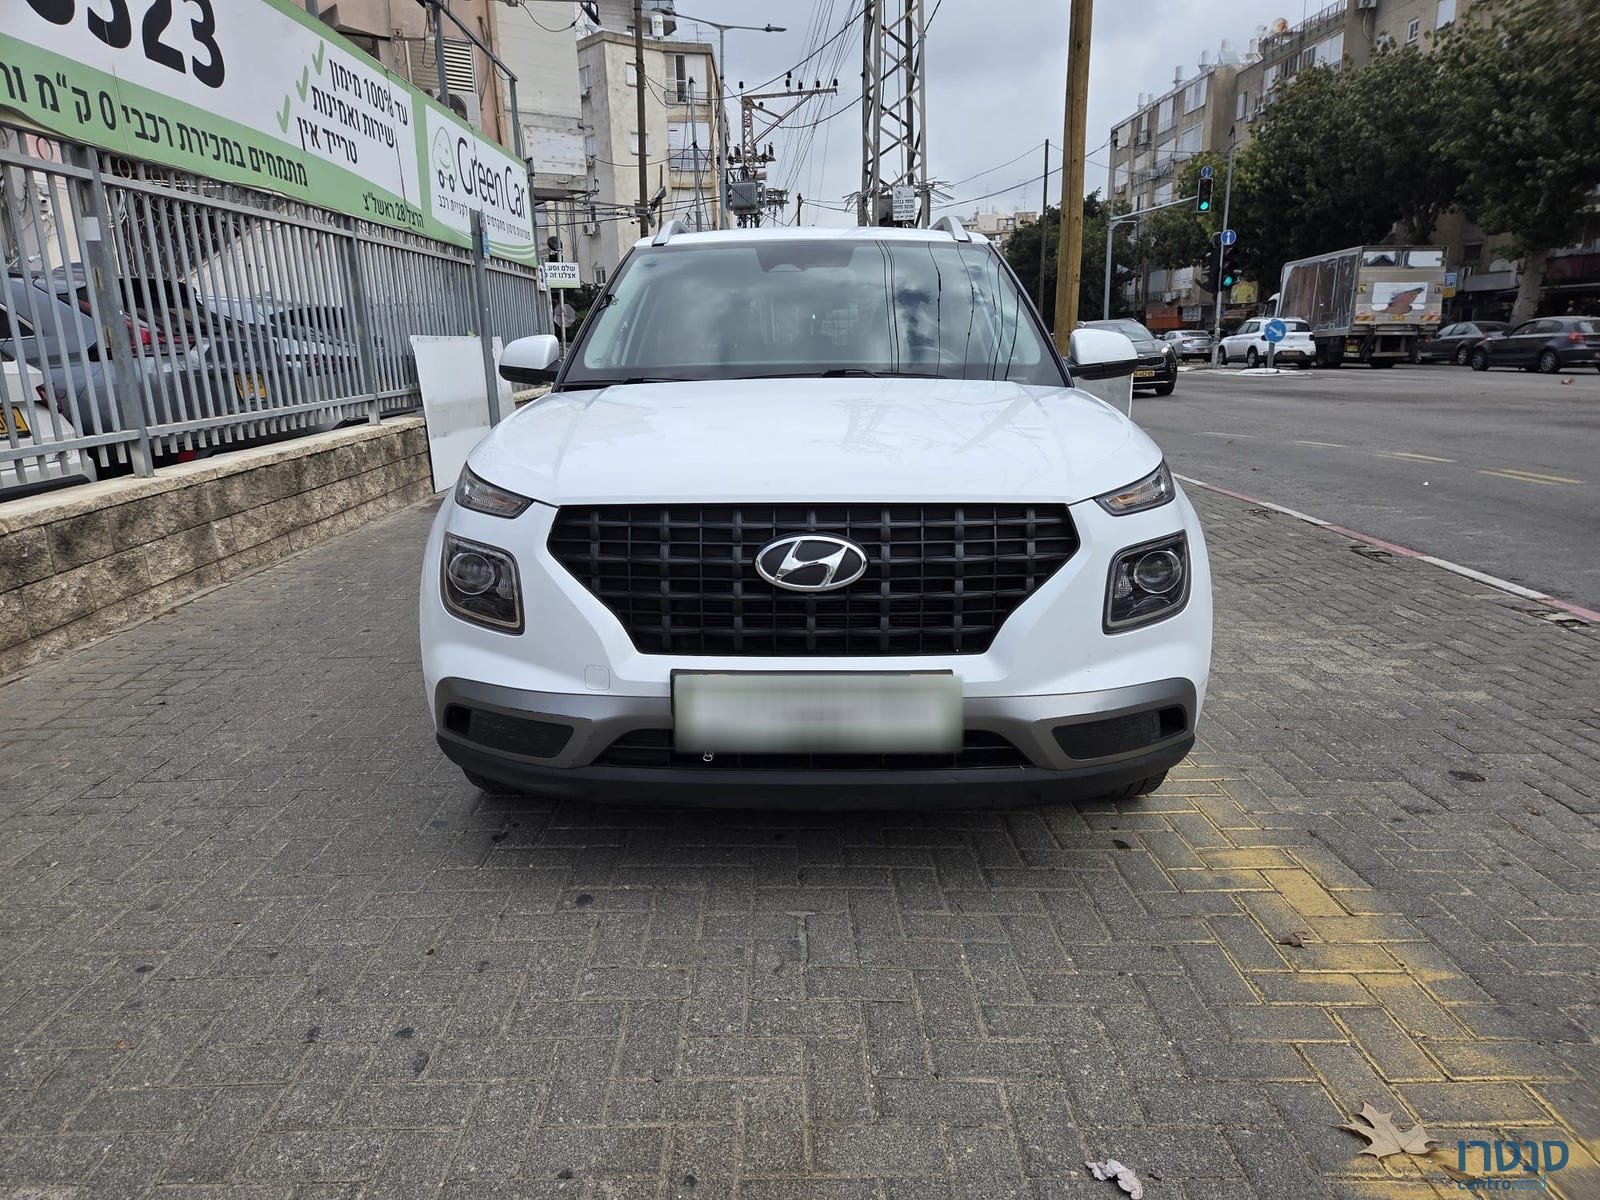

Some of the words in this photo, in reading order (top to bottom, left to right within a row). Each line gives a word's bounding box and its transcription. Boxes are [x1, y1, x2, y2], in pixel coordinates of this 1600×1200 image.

[328, 58, 362, 99] מימון
[98, 90, 117, 131] 0
[310, 84, 361, 133] ואמינות
[364, 78, 394, 118] 100%
[394, 100, 408, 126] עד
[121, 104, 174, 148] רכבי
[176, 121, 247, 168] במכירת
[296, 116, 322, 152] אין
[361, 112, 395, 148] שירות
[321, 127, 358, 164] טרייד
[247, 145, 309, 187] מתמחים
[457, 136, 505, 210] Green
[504, 165, 526, 220] Car
[395, 202, 406, 222] 28
[406, 208, 425, 229] הרצל
[437, 194, 450, 210] רכב
[558, 271, 576, 279] אצלנו
